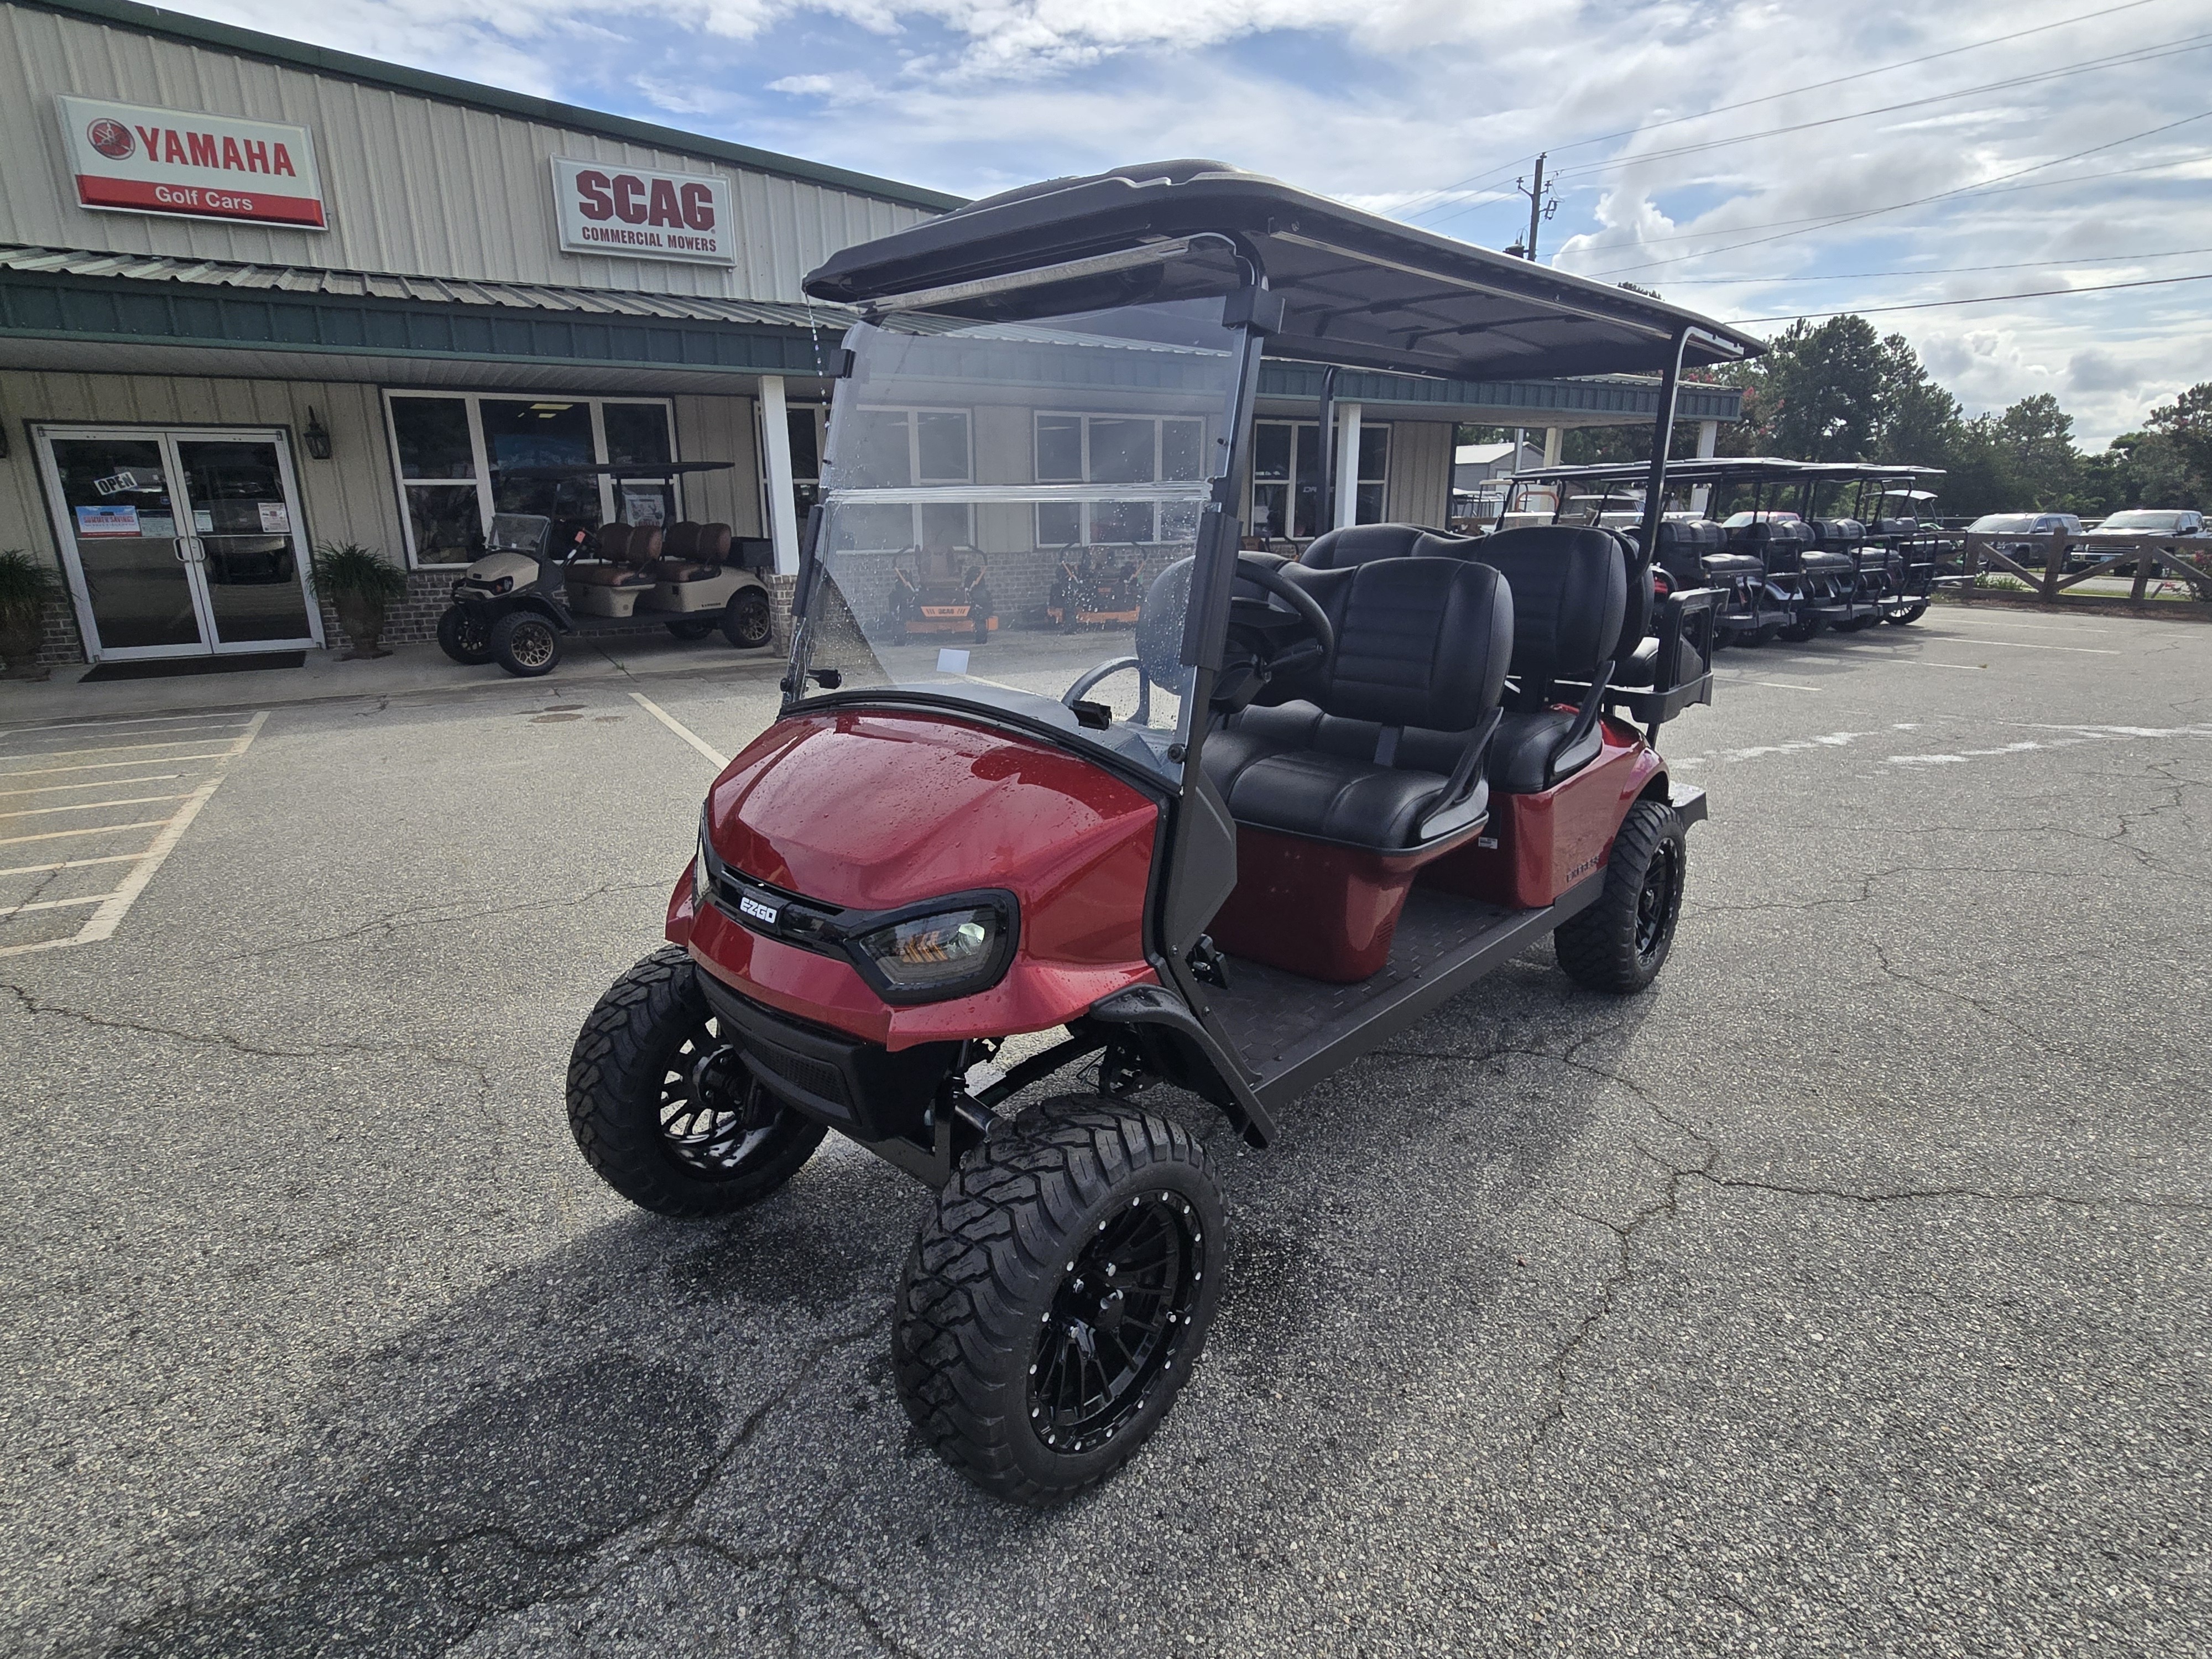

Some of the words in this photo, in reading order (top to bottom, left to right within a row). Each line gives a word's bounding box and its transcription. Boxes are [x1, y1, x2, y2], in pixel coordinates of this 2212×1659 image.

[134, 125, 296, 177] YAMAHA
[155, 186, 198, 205] Golf
[205, 191, 253, 211] Cars
[576, 170, 715, 231] SCAG
[582, 226, 663, 247] COMMERCIAL
[667, 234, 717, 252] MOWERS
[98, 473, 135, 493] OPEN
